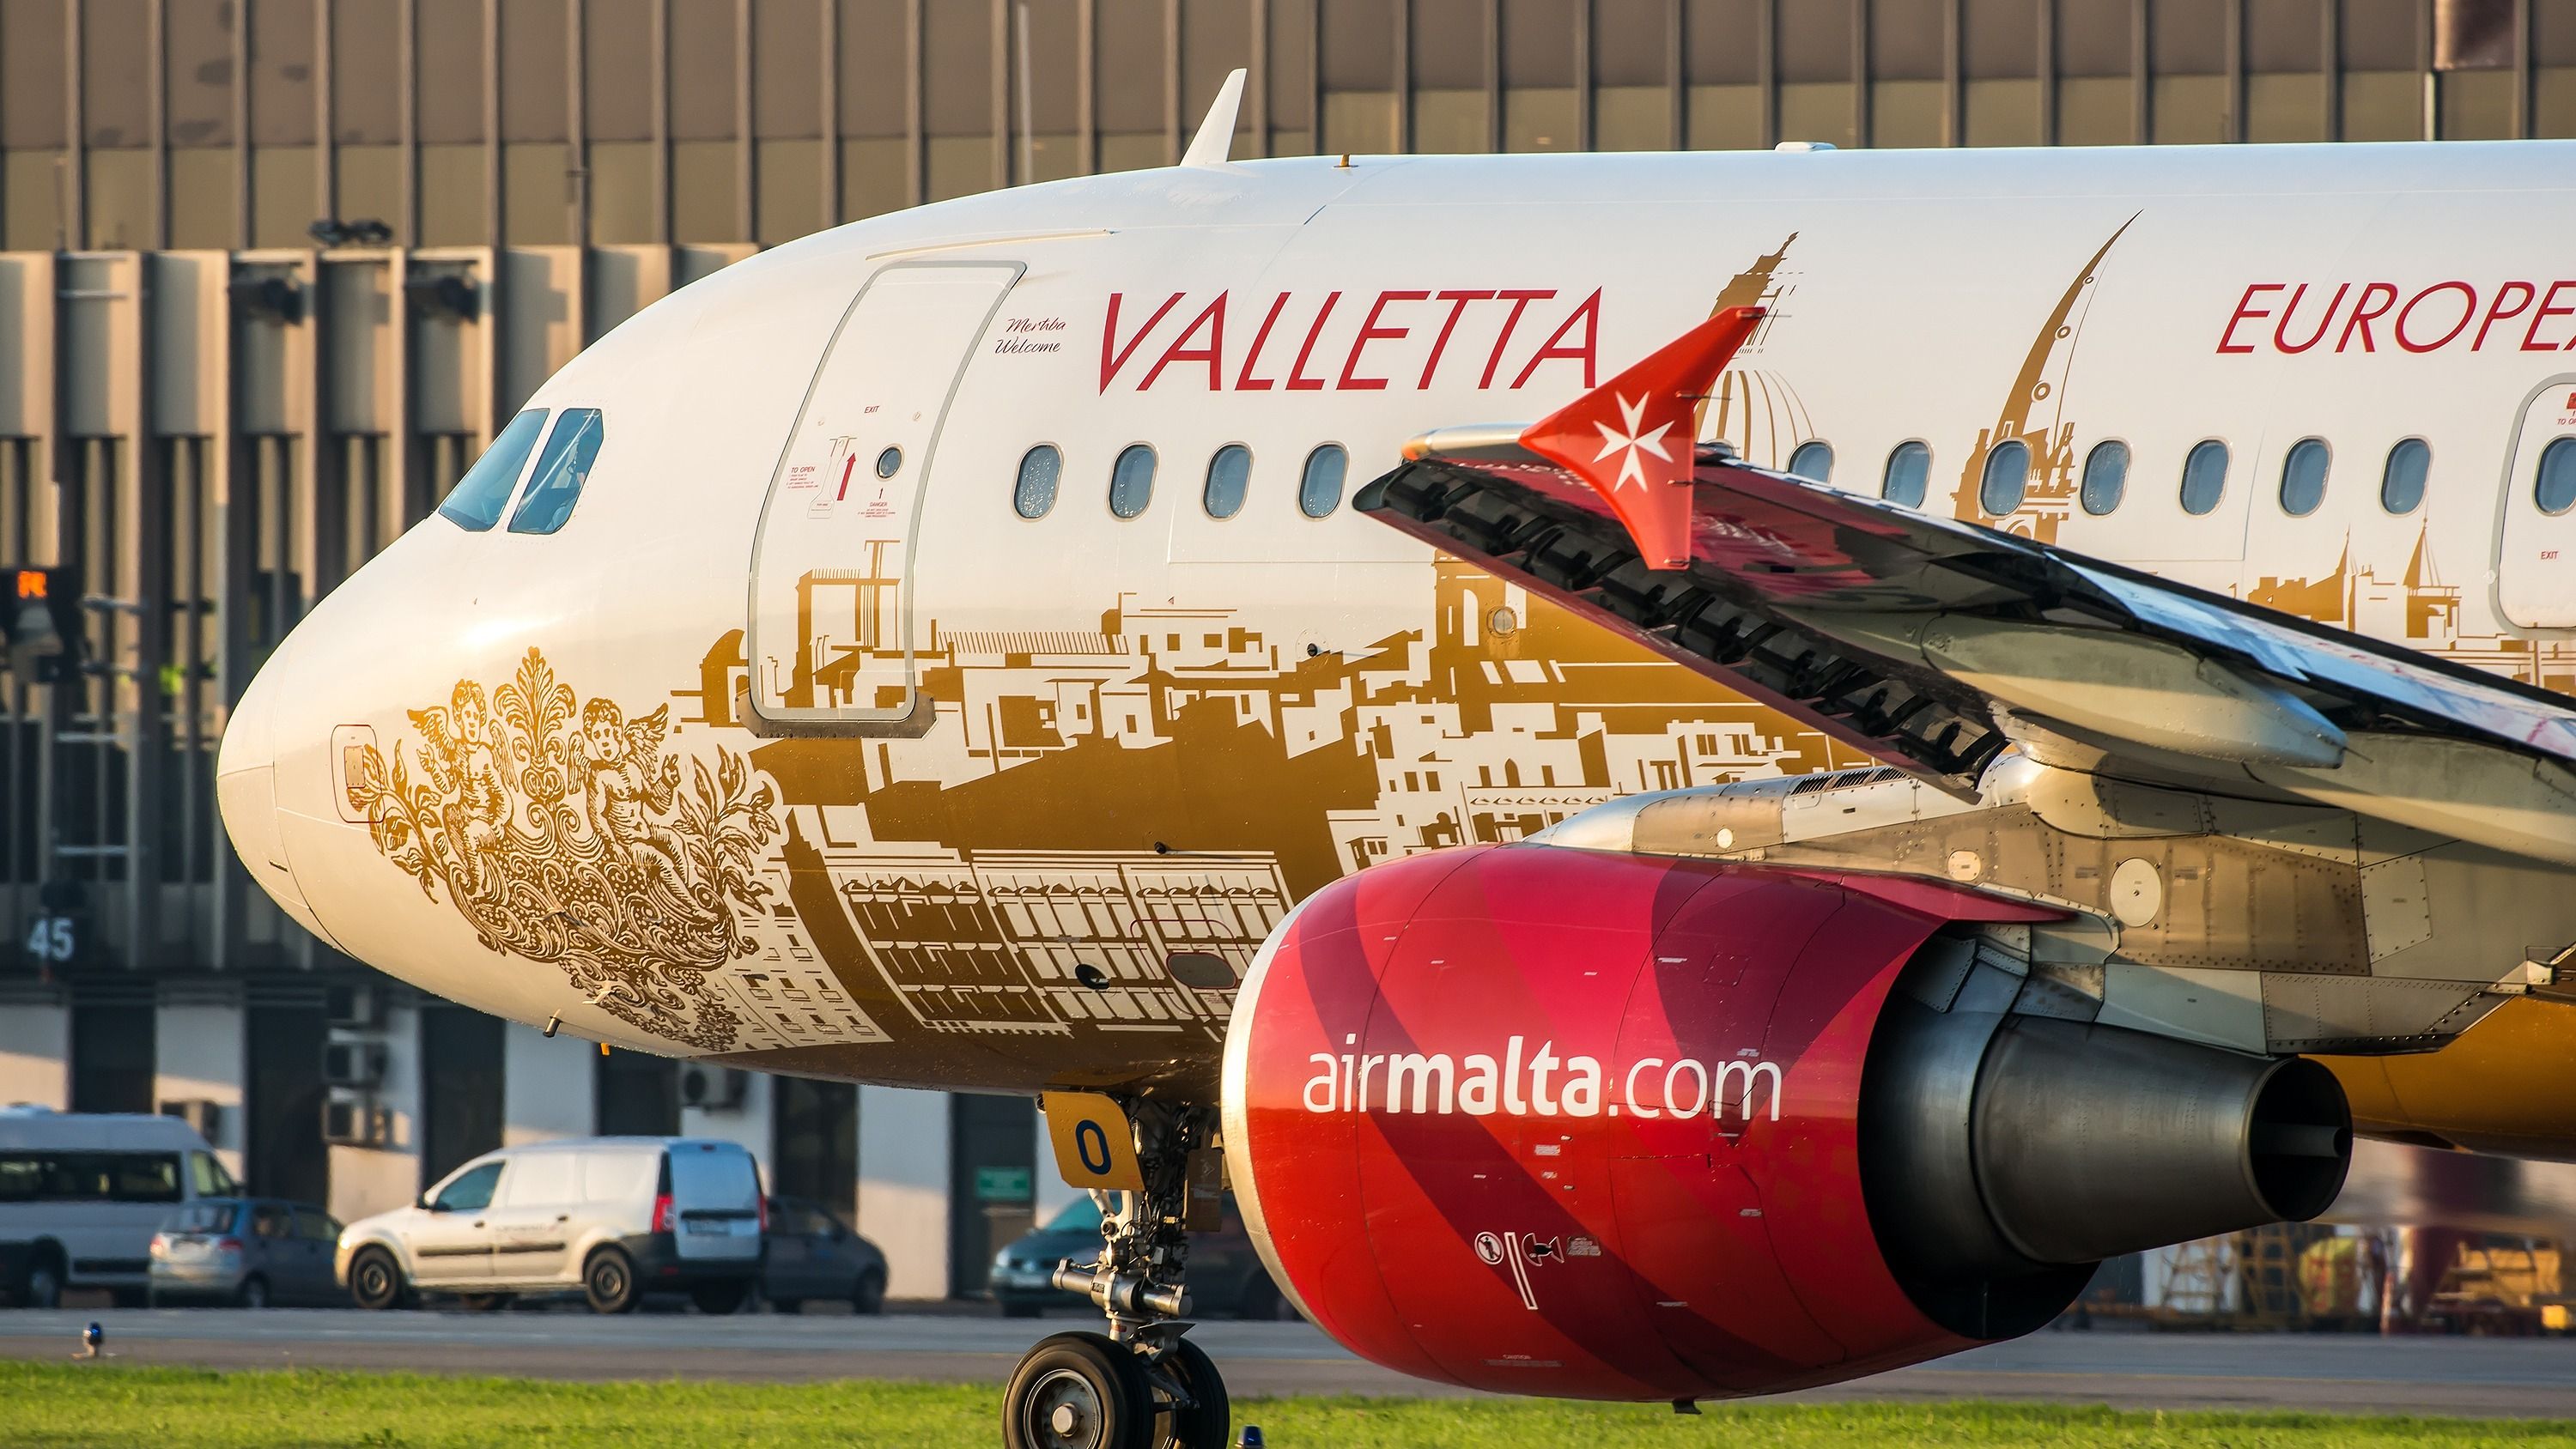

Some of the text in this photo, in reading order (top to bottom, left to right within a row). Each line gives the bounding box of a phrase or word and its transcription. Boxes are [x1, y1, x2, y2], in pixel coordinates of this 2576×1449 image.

[994, 336, 1061, 354] Welcome
[1099, 286, 1602, 397] VALLETTA
[2215, 281, 2576, 354] EUROPE
[2541, 550, 2559, 560] EXIT
[27, 917, 74, 961] 45
[1303, 1033, 1783, 1122] airmalta.com
